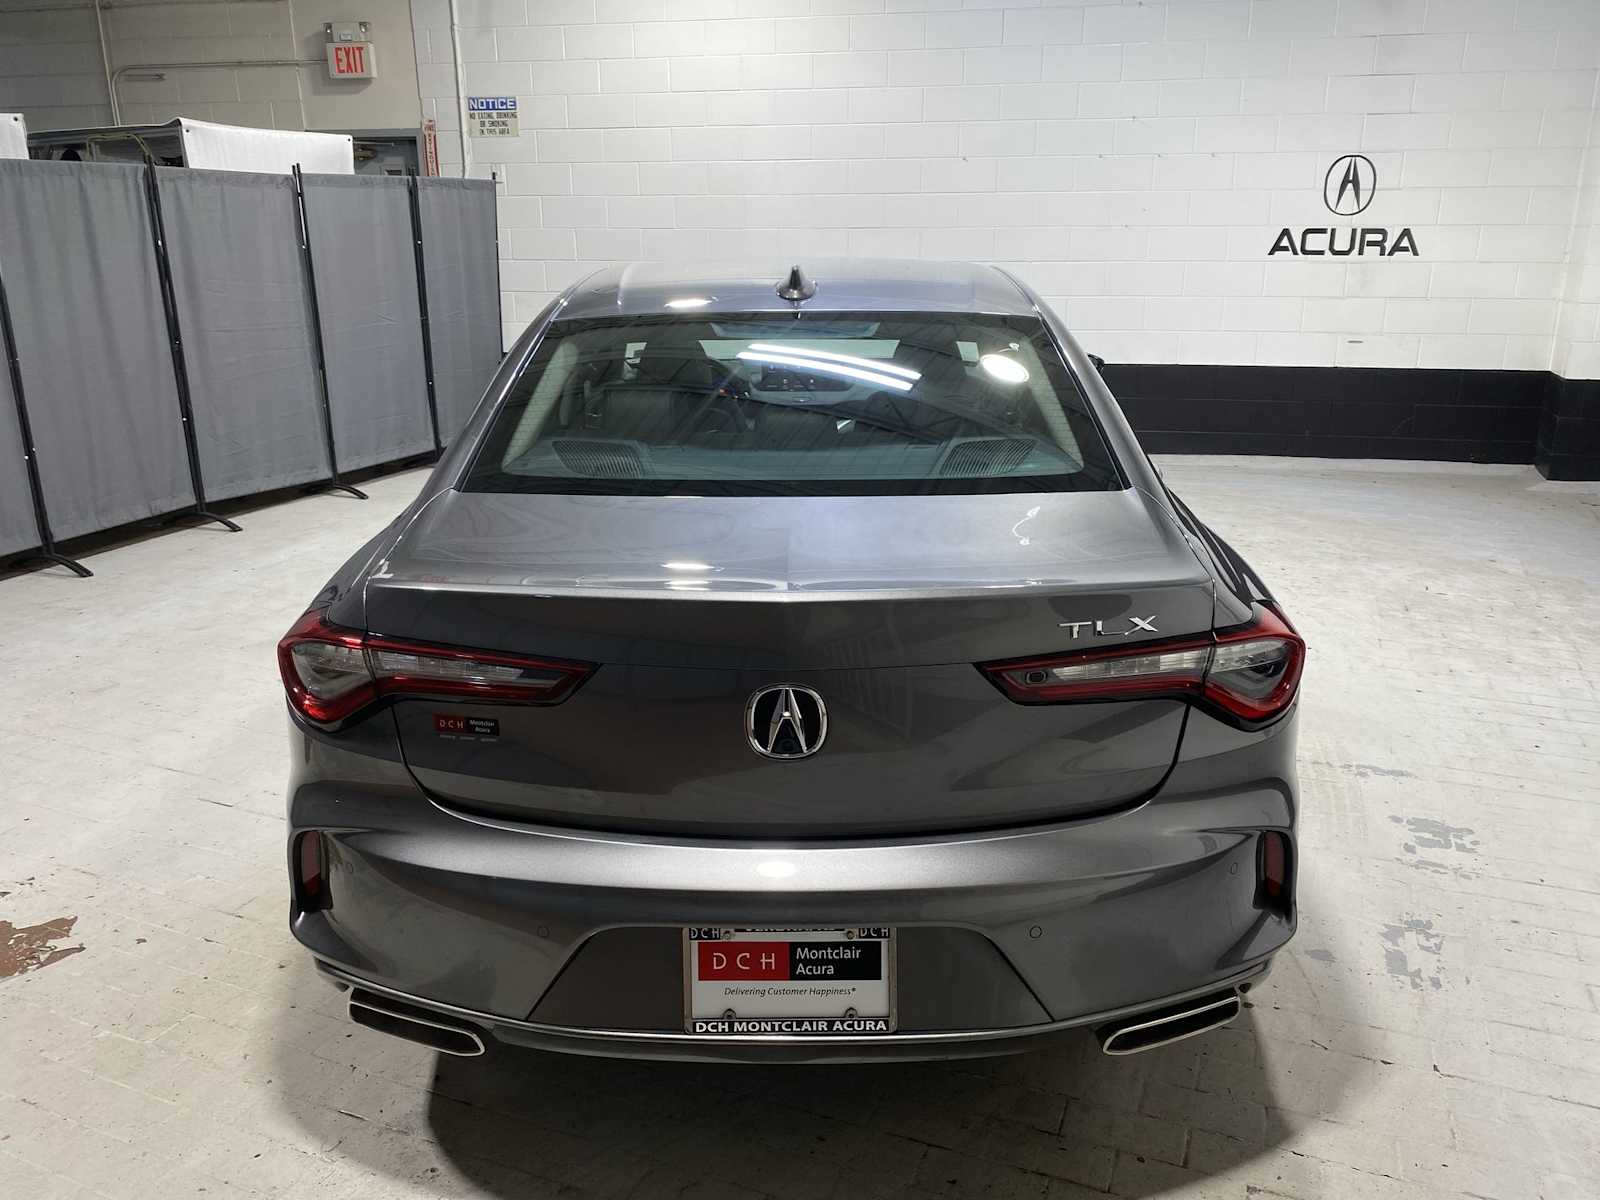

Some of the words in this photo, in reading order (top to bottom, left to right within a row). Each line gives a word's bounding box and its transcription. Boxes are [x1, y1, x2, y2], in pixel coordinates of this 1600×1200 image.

[334, 46, 364, 73] EXIT
[469, 98, 517, 110] NOTICE
[1267, 228, 1420, 256] ACURA
[1058, 615, 1159, 639] TLX
[796, 946, 862, 960] Montclair
[795, 963, 835, 975] Acura
[724, 987, 766, 998] Delivering
[767, 987, 807, 996] Customer
[695, 1022, 729, 1033] DCH
[733, 1020, 828, 1032] MONTCLAIR
[832, 1020, 887, 1031] ACURA
